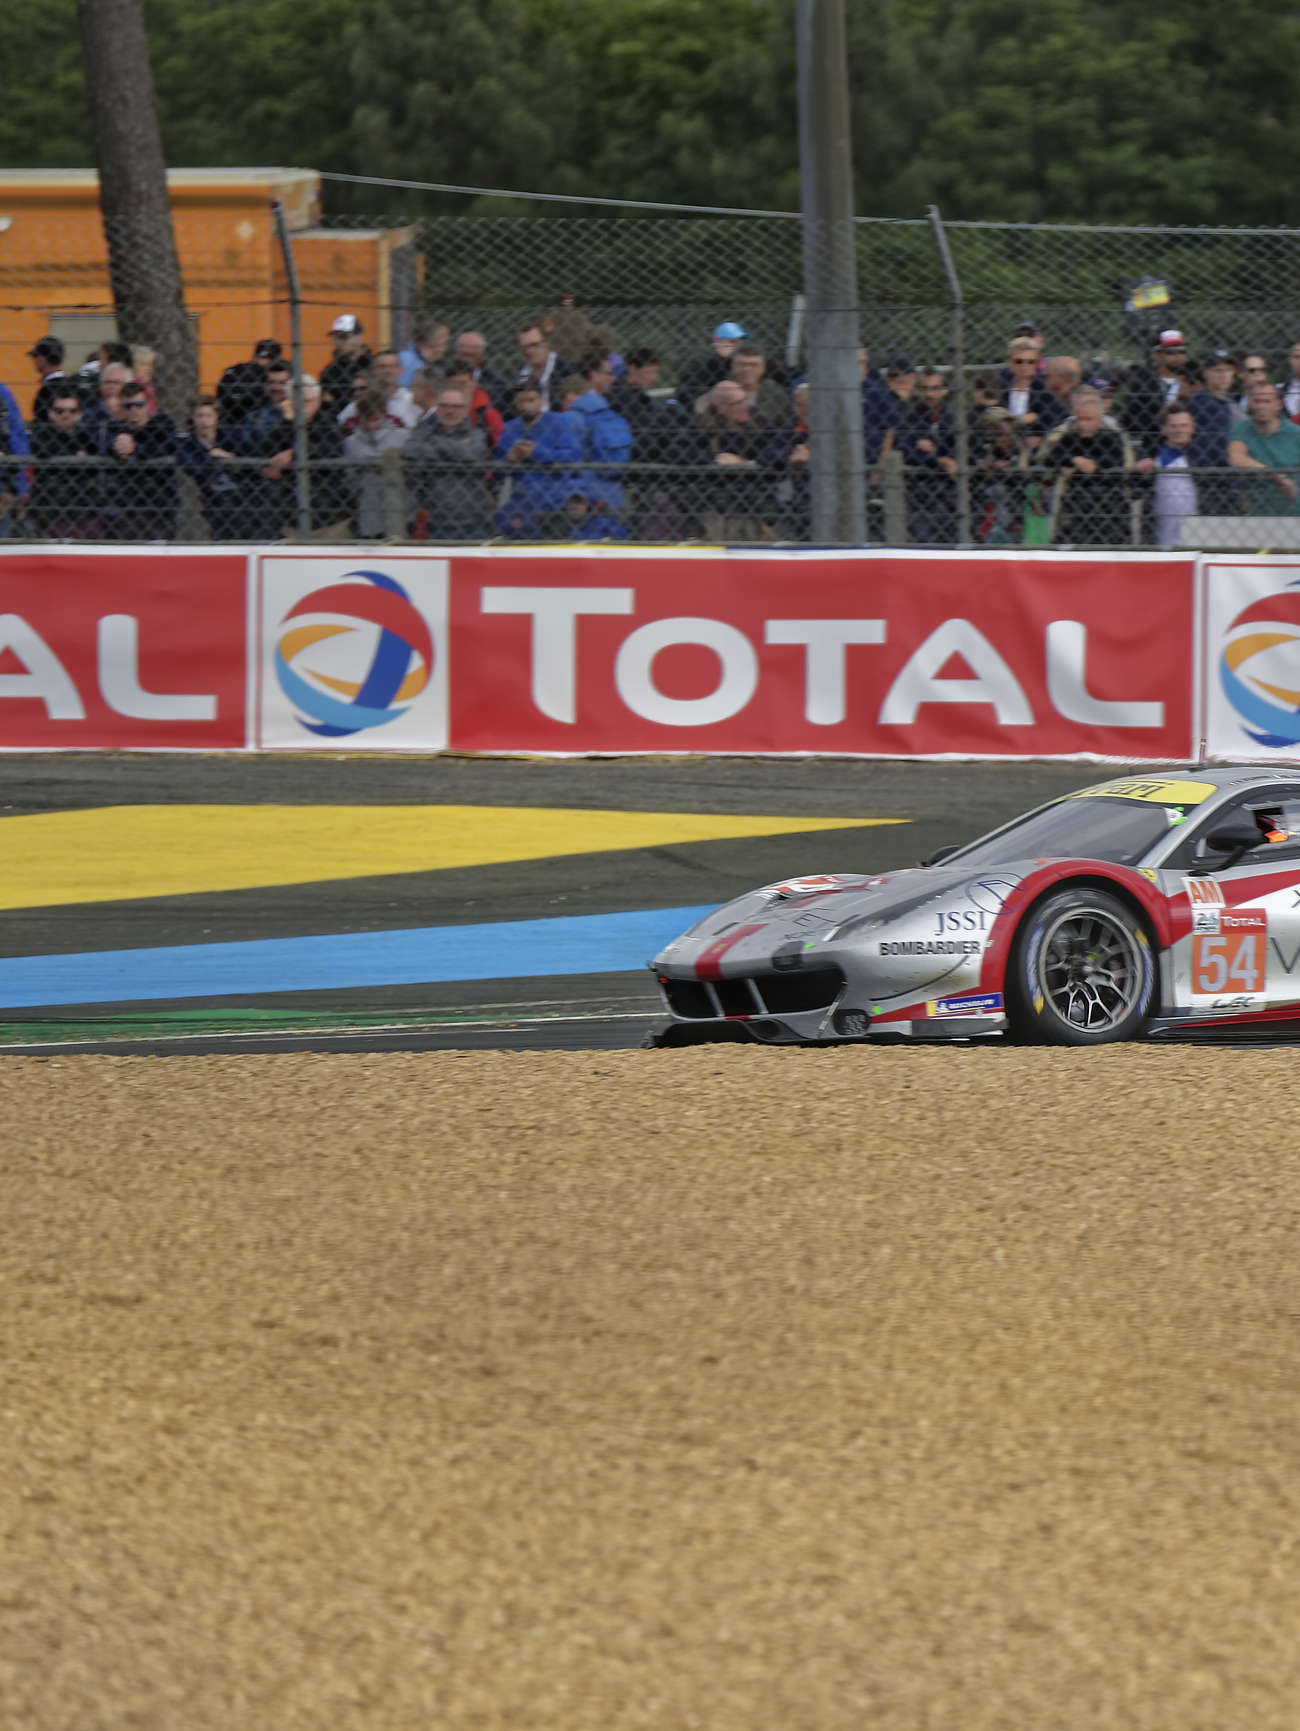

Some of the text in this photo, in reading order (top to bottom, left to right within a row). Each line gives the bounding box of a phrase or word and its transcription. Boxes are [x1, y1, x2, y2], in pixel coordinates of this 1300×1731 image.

[481, 587, 1164, 728] TOTAL
[933, 911, 989, 936] JSSI
[1221, 916, 1267, 927] TOTAL
[879, 940, 981, 956] BOMBARDIER
[1198, 934, 1260, 993] 54
